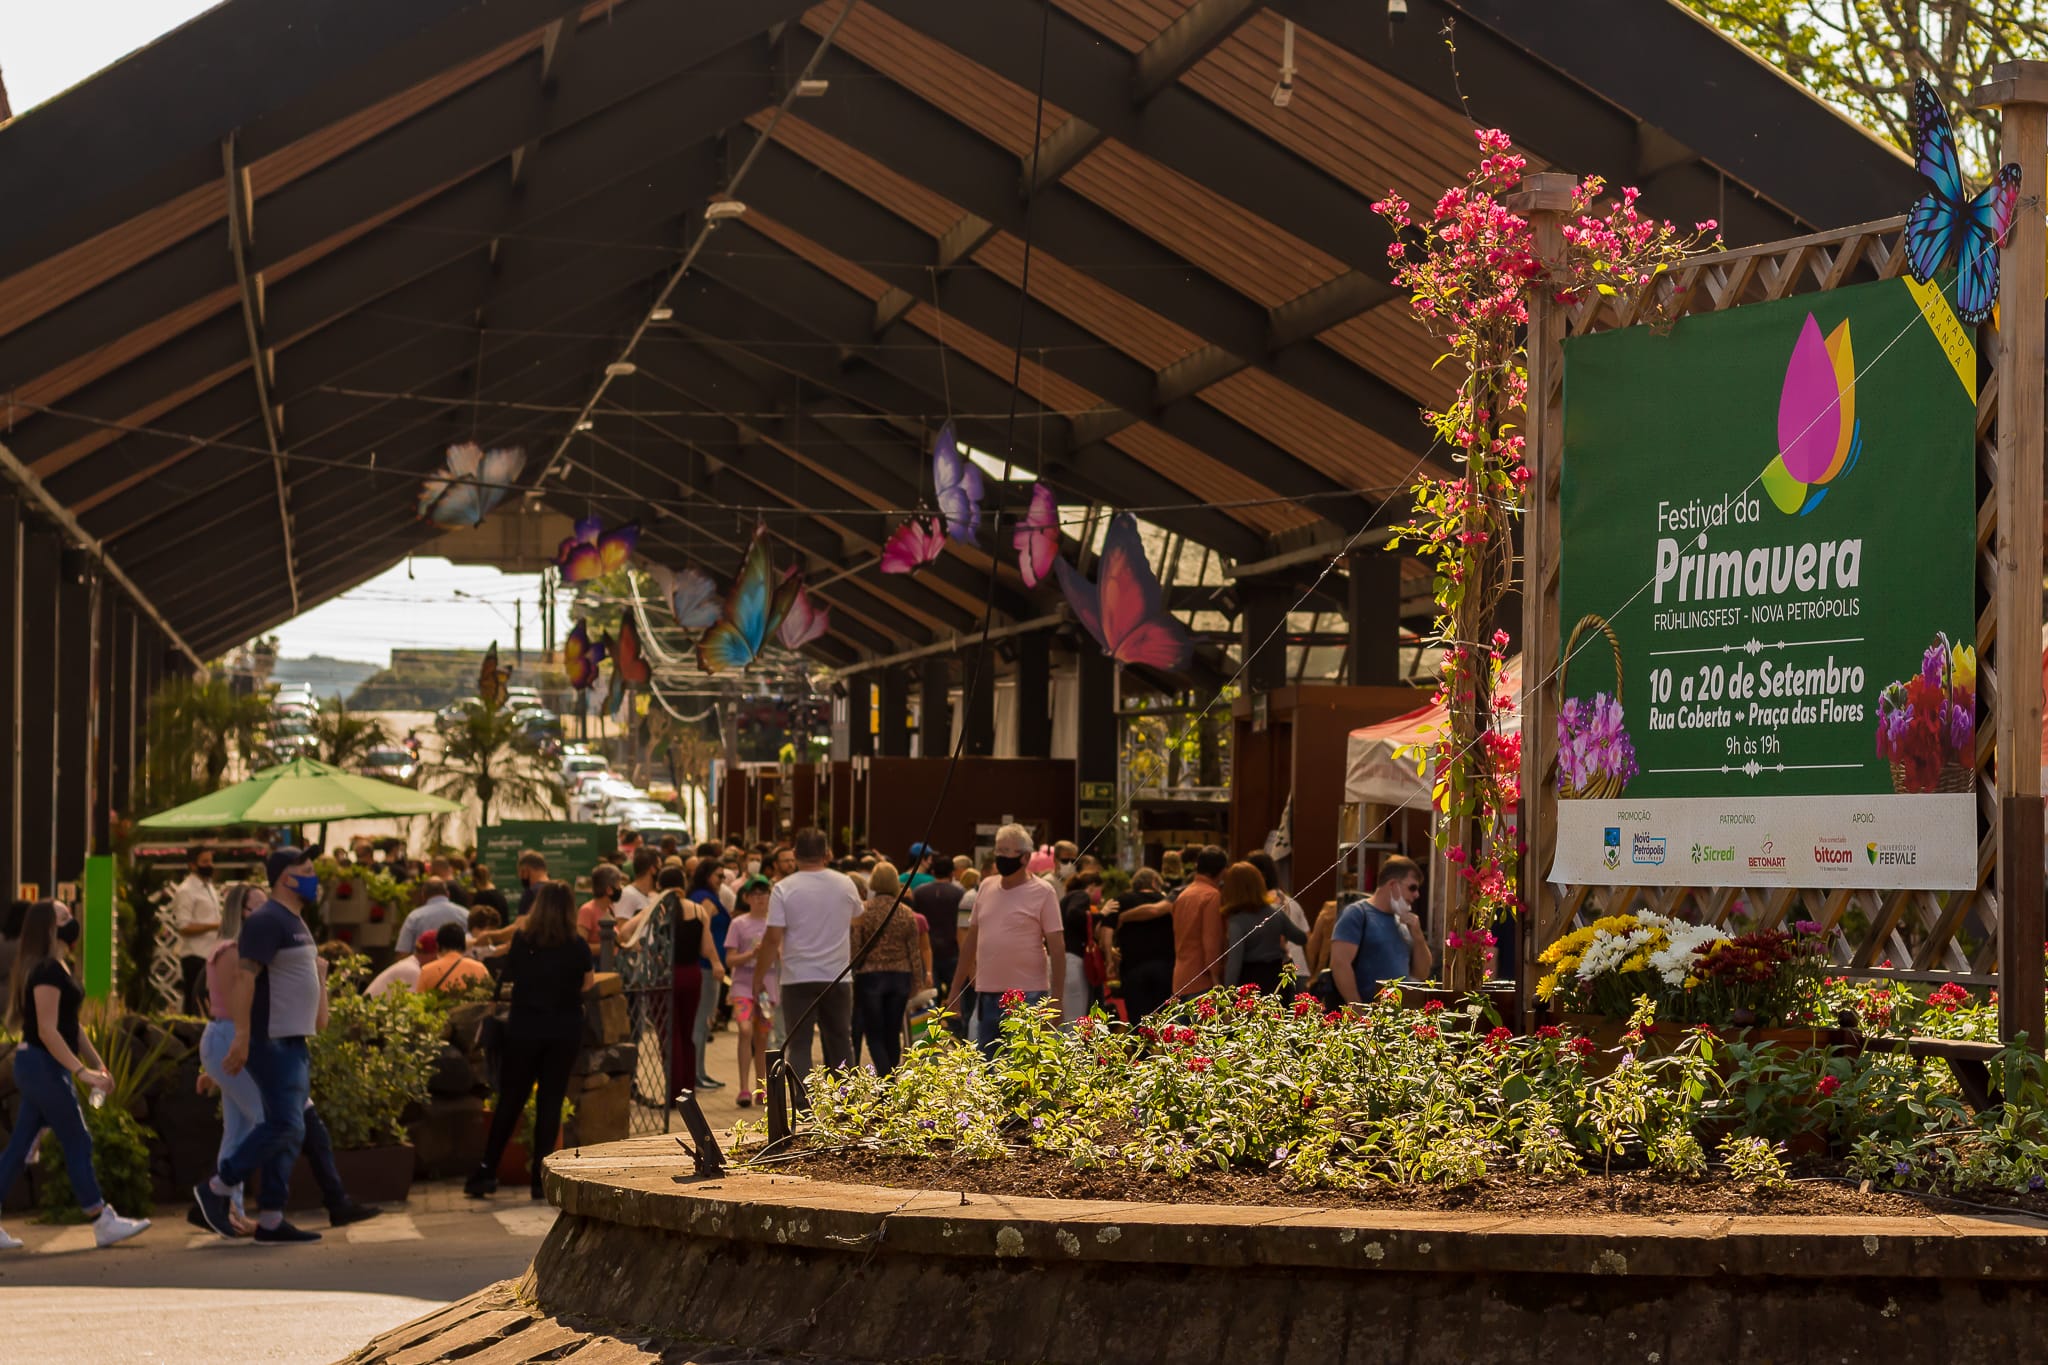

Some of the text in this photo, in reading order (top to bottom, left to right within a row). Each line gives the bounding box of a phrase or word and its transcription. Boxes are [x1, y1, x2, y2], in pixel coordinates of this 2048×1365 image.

[1927, 282, 1971, 359] ENTRADA
[1658, 490, 1760, 532] Festival da
[1653, 532, 1862, 604] Primavera
[1654, 607, 1741, 631] FRÜHLINGSFEST
[1751, 604, 1784, 624] NOVA
[1787, 596, 1860, 621] PETRÓPOLIS
[1649, 655, 1865, 704] 10 a 20 de Setembro
[1649, 698, 1864, 731] Rua Coberta Praça das Flores
[1726, 734, 1780, 755] 9h às 19h
[1703, 846, 1735, 862] Sicredi
[1748, 857, 1786, 867] BETONART
[1814, 845, 1853, 864] bitcom
[1879, 852, 1917, 865] FEEVALE
